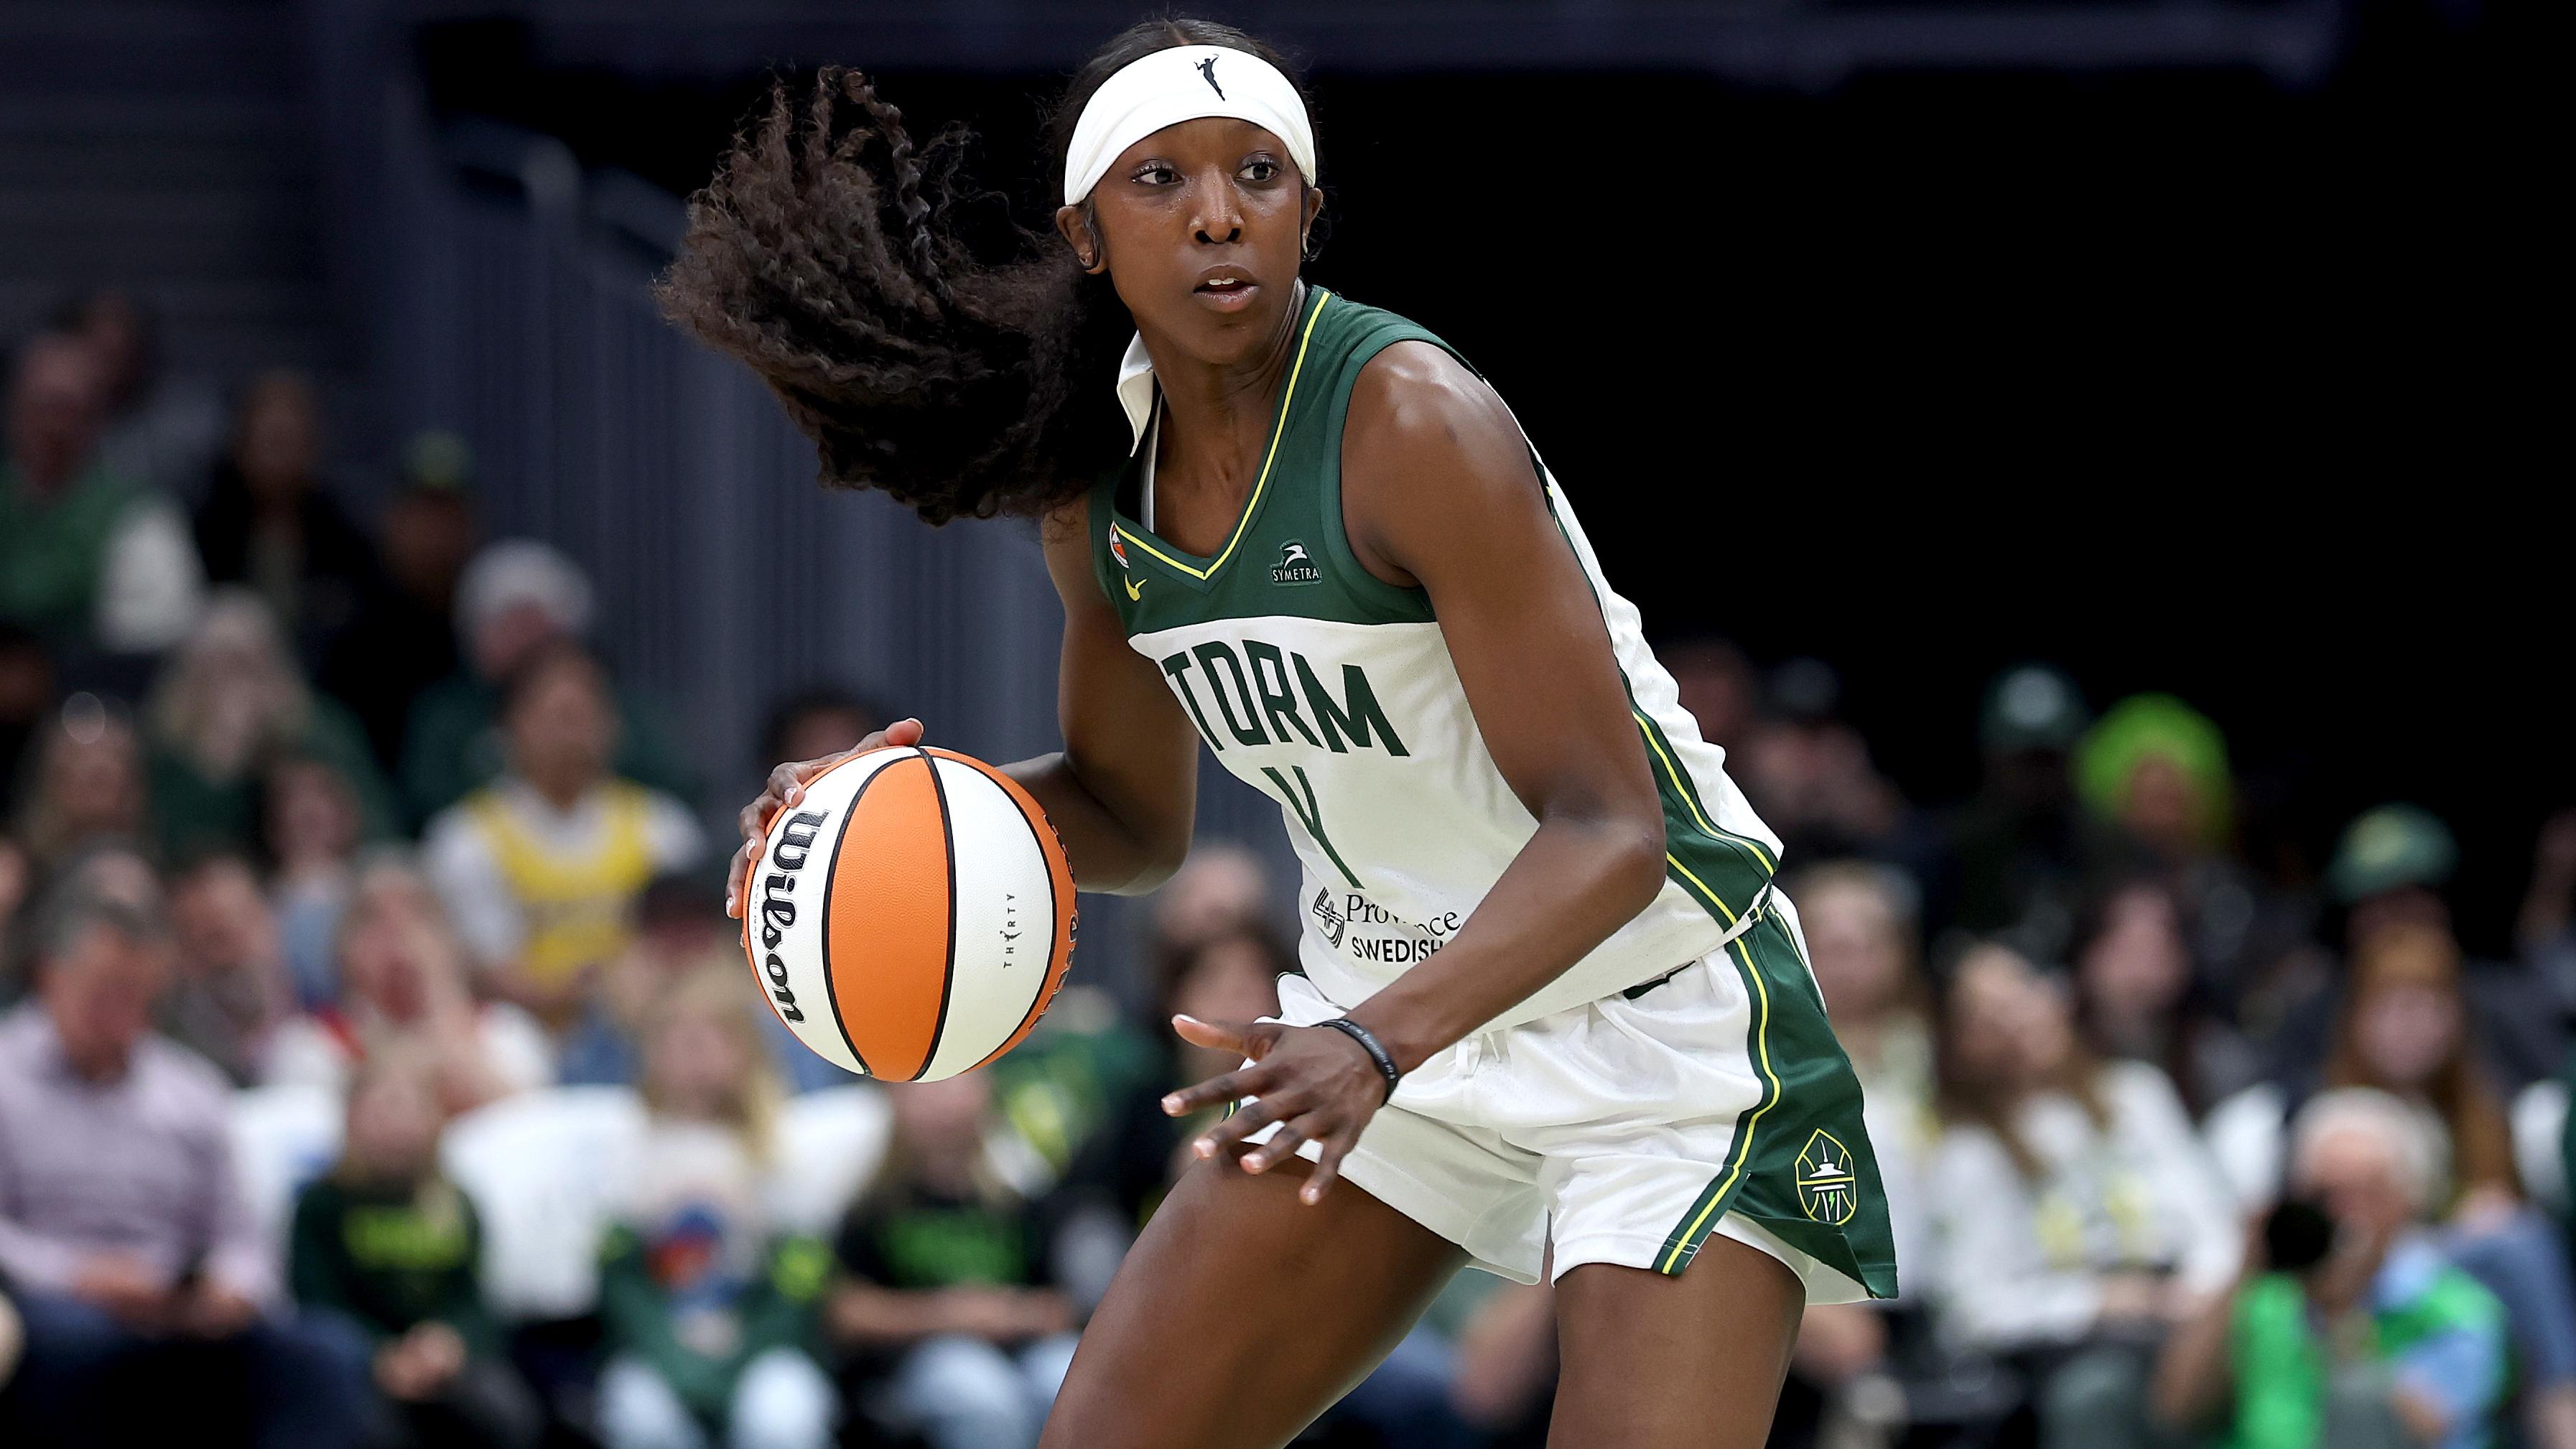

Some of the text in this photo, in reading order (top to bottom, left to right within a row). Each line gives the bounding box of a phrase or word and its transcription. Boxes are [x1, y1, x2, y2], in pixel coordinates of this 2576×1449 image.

[1272, 567, 1319, 582] SYMETRA
[1161, 639, 1411, 758] TORM
[762, 809, 832, 1025] Wilson
